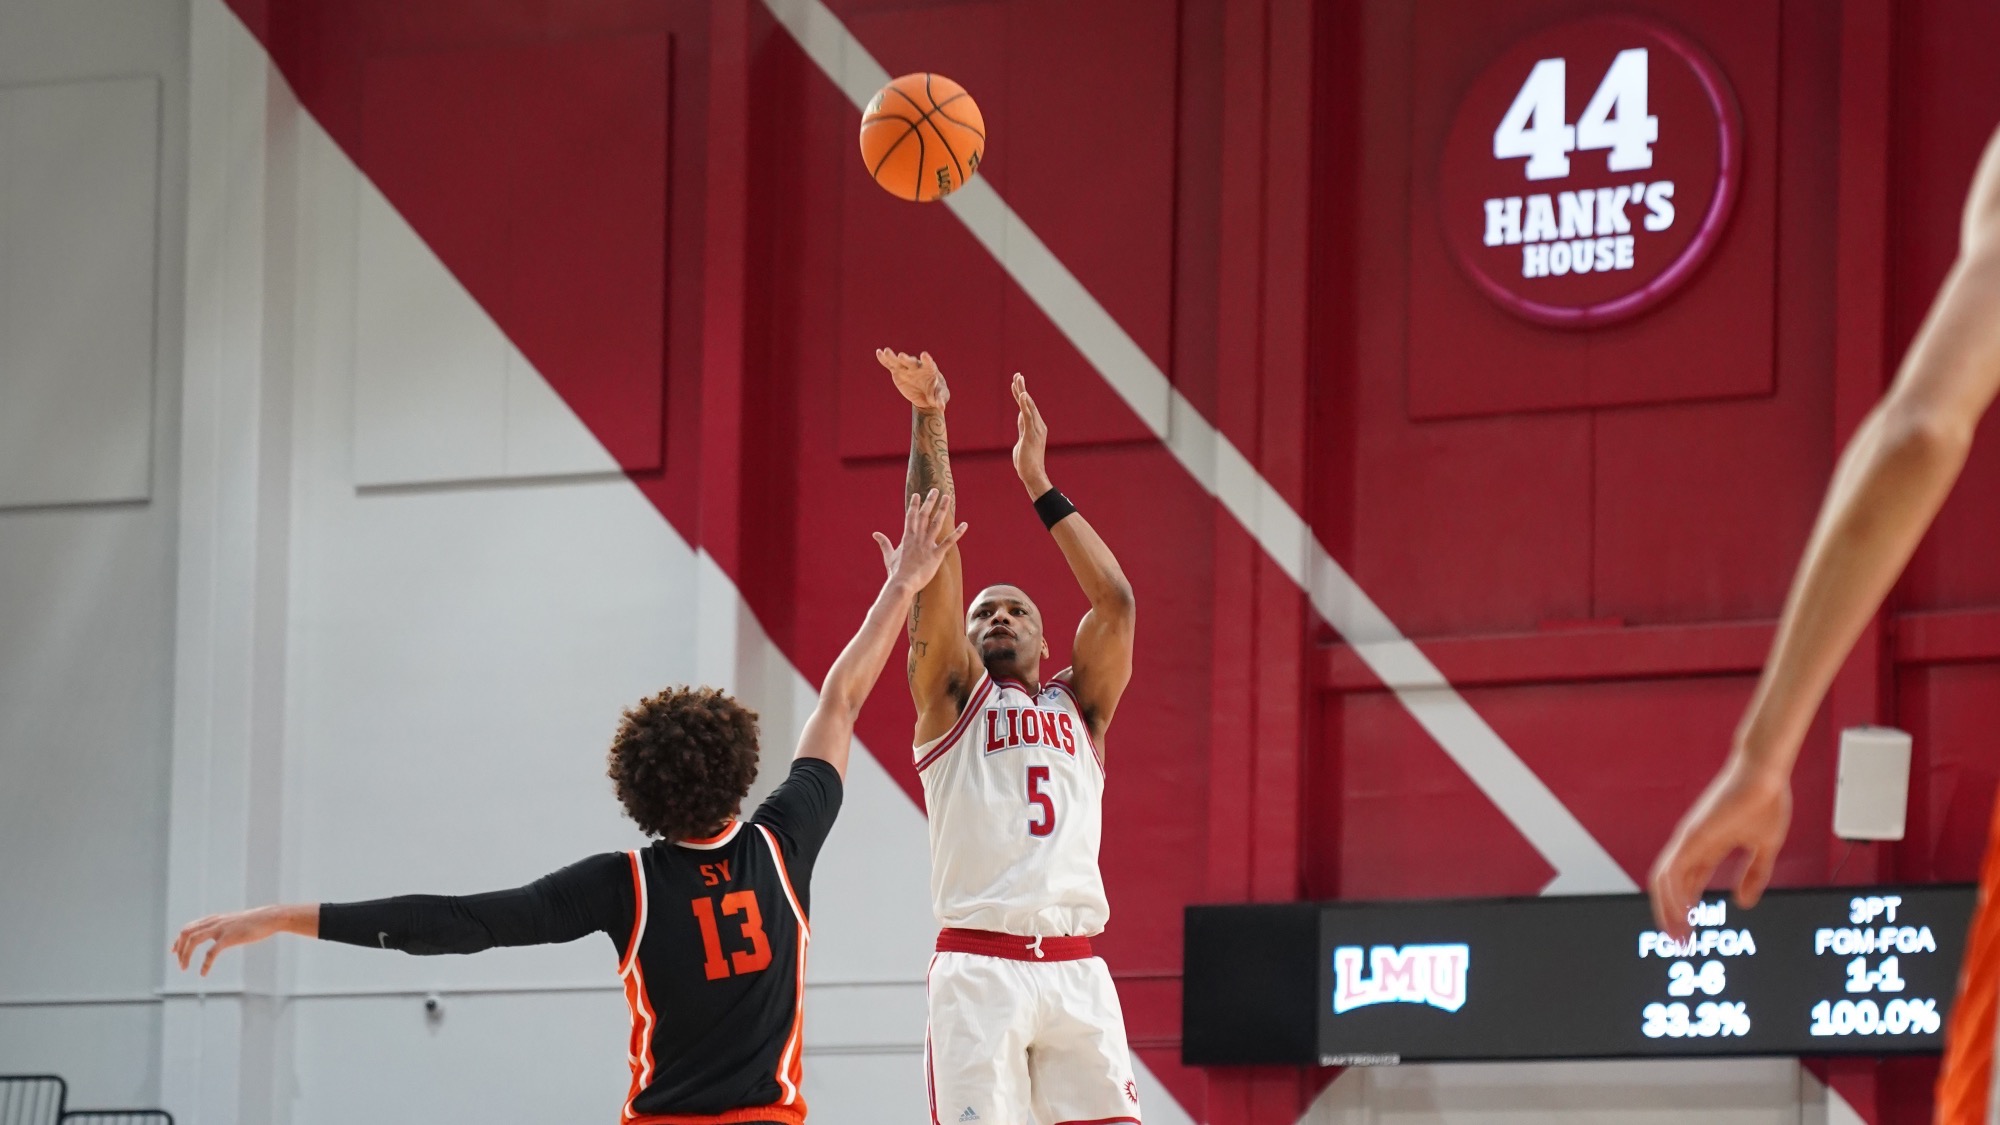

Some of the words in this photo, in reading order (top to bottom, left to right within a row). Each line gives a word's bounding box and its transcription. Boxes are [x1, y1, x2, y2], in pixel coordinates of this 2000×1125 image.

[1493, 47, 1659, 181] 44
[1483, 180, 1675, 247] HANK'S
[1522, 235, 1635, 278] HOUSE
[984, 706, 1077, 760] LIONS
[1026, 765, 1056, 838] 5
[700, 859, 732, 887] SY
[1687, 899, 1727, 927] otal
[1849, 896, 1902, 923] 3PT
[691, 890, 773, 981] 13
[1814, 925, 1937, 955] FGM-FGA
[1333, 943, 1470, 1015] LMU
[1667, 960, 1726, 997] 2-6
[1845, 956, 1905, 993] 1-1
[1641, 1001, 1751, 1038] 33.3%
[1809, 998, 1941, 1036] 100.0%
